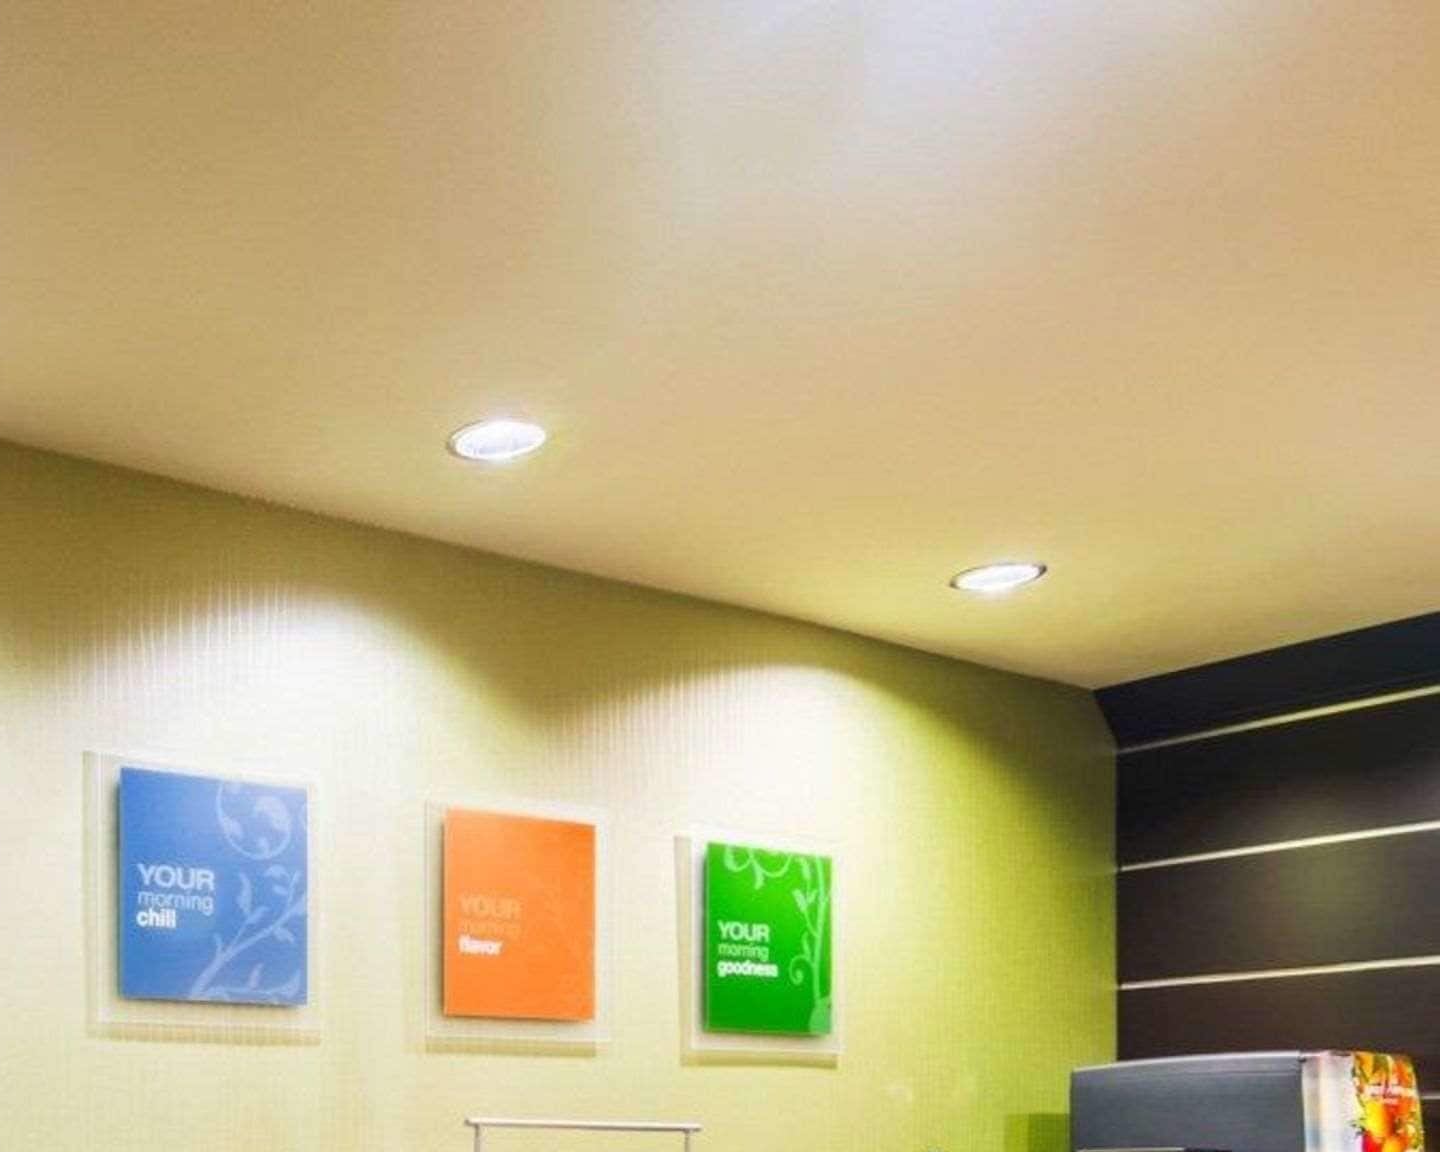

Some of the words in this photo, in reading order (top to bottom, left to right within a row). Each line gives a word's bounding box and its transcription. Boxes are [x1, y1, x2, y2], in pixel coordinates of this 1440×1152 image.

[137, 863, 216, 892] YOUR
[137, 890, 215, 917] morning
[136, 907, 177, 929] chill
[717, 919, 770, 943] YOUR
[717, 960, 779, 978] goodness
